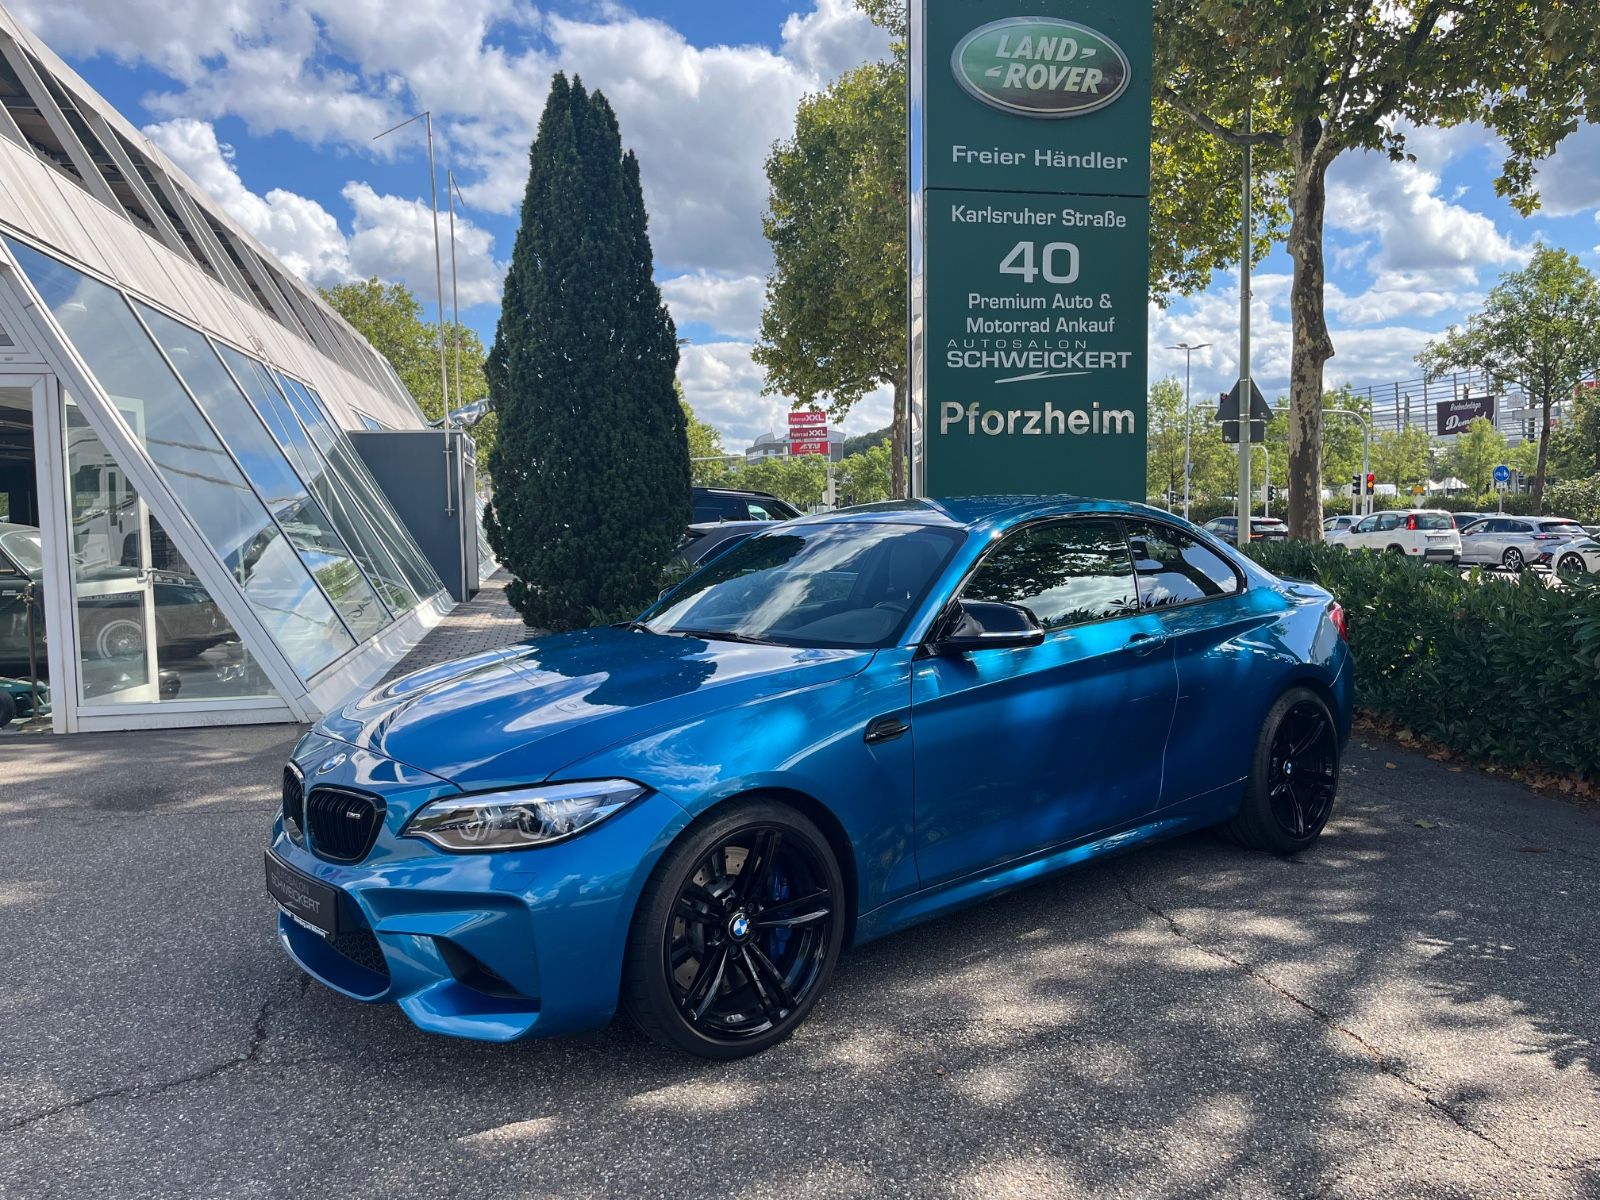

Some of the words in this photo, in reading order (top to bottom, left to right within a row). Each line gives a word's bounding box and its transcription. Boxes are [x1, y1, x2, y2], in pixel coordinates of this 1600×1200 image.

[951, 144, 1026, 166] Freier
[1034, 148, 1128, 170] Händler
[951, 204, 1057, 226] Karlsruher
[1062, 208, 1127, 228] Straße
[999, 241, 1080, 284] 40
[968, 293, 1047, 309] Premium
[1052, 293, 1094, 309] Auto
[1099, 293, 1113, 309] &
[966, 317, 1050, 334] Motorrad
[1055, 316, 1115, 333] Ankauf
[946, 339, 1088, 349] AUTOSALON
[946, 350, 1132, 369] SCHWEICKERT
[939, 401, 1136, 436] Pforzheim
[808, 429, 826, 437] XXL
